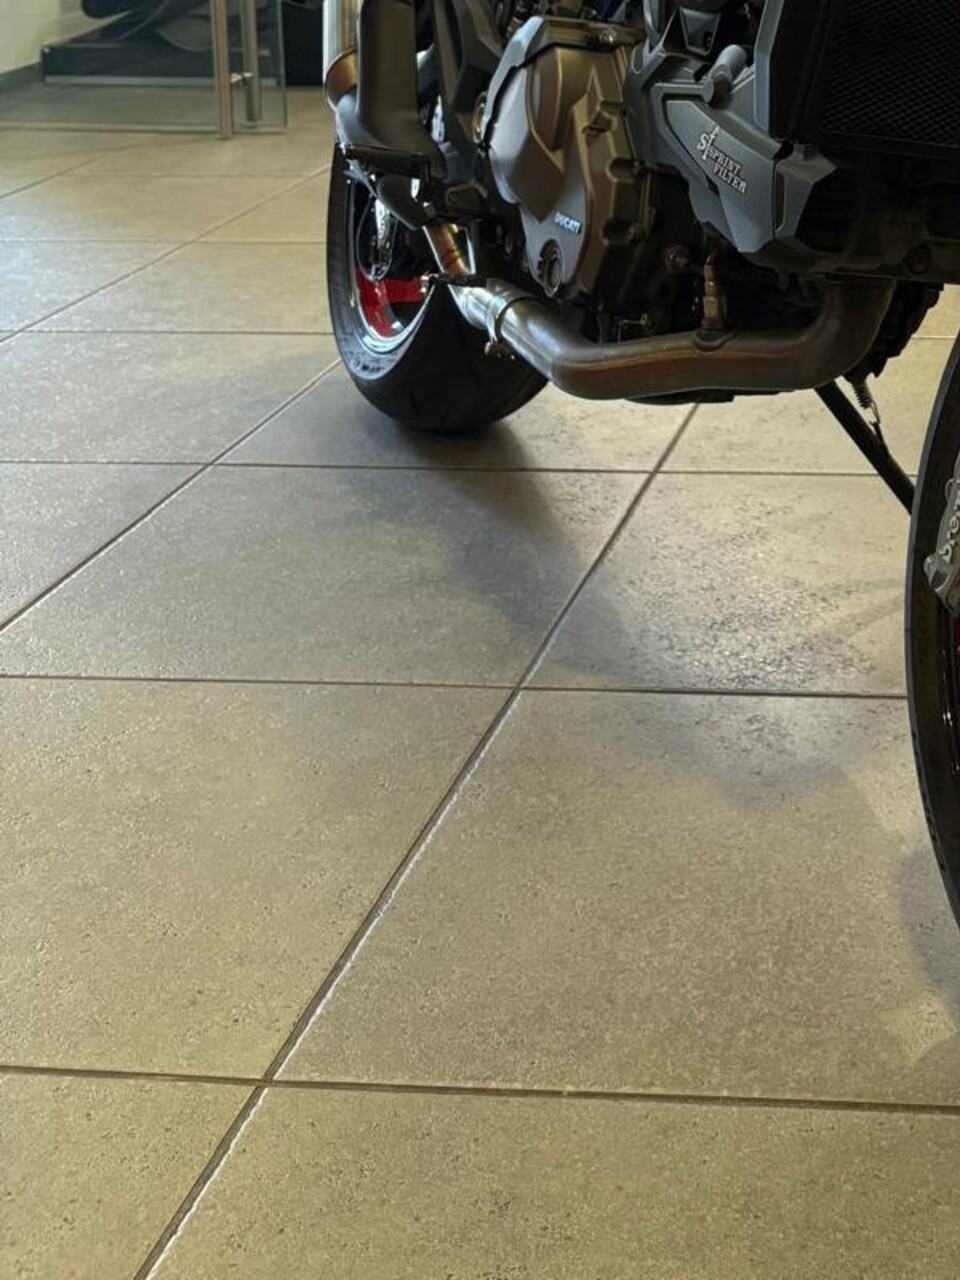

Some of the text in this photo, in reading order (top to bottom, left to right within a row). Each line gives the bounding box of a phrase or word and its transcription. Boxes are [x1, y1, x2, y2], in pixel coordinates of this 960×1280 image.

[708, 148, 743, 173] SPRINT
[712, 163, 748, 194] FILTER
[554, 211, 582, 234] DUCATI
